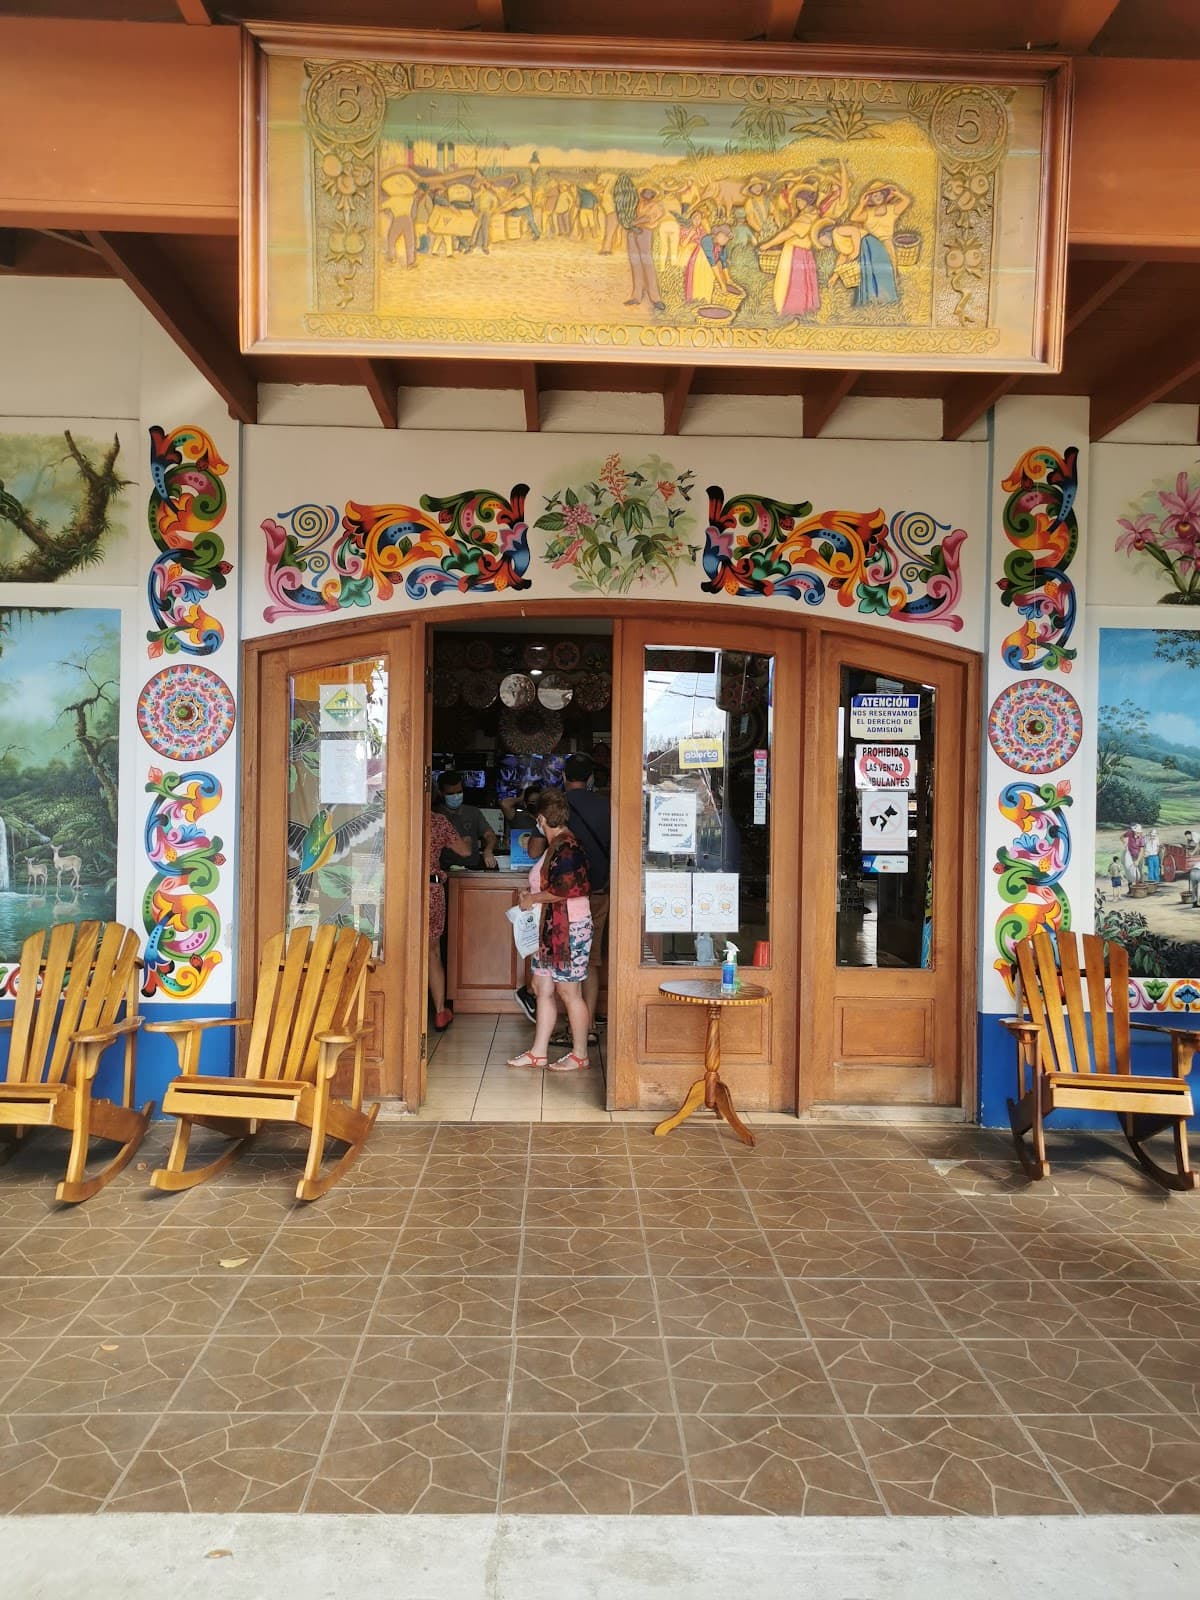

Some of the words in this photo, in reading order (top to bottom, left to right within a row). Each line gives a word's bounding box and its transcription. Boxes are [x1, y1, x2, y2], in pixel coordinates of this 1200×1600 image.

[414, 64, 525, 92] BANCO
[534, 69, 673, 97] CENTRAL
[678, 72, 720, 98] DE
[727, 75, 826, 101] COSTA
[833, 78, 900, 104] RICA
[335, 85, 361, 124] 5
[955, 104, 981, 145] 5
[548, 324, 628, 345] CINCO
[861, 695, 910, 707] ATENCIÓN
[862, 747, 909, 758] PROHIBIDAS
[865, 763, 877, 772] LAS
[879, 763, 903, 772] VENTAS
[861, 777, 910, 787] BULANTES
